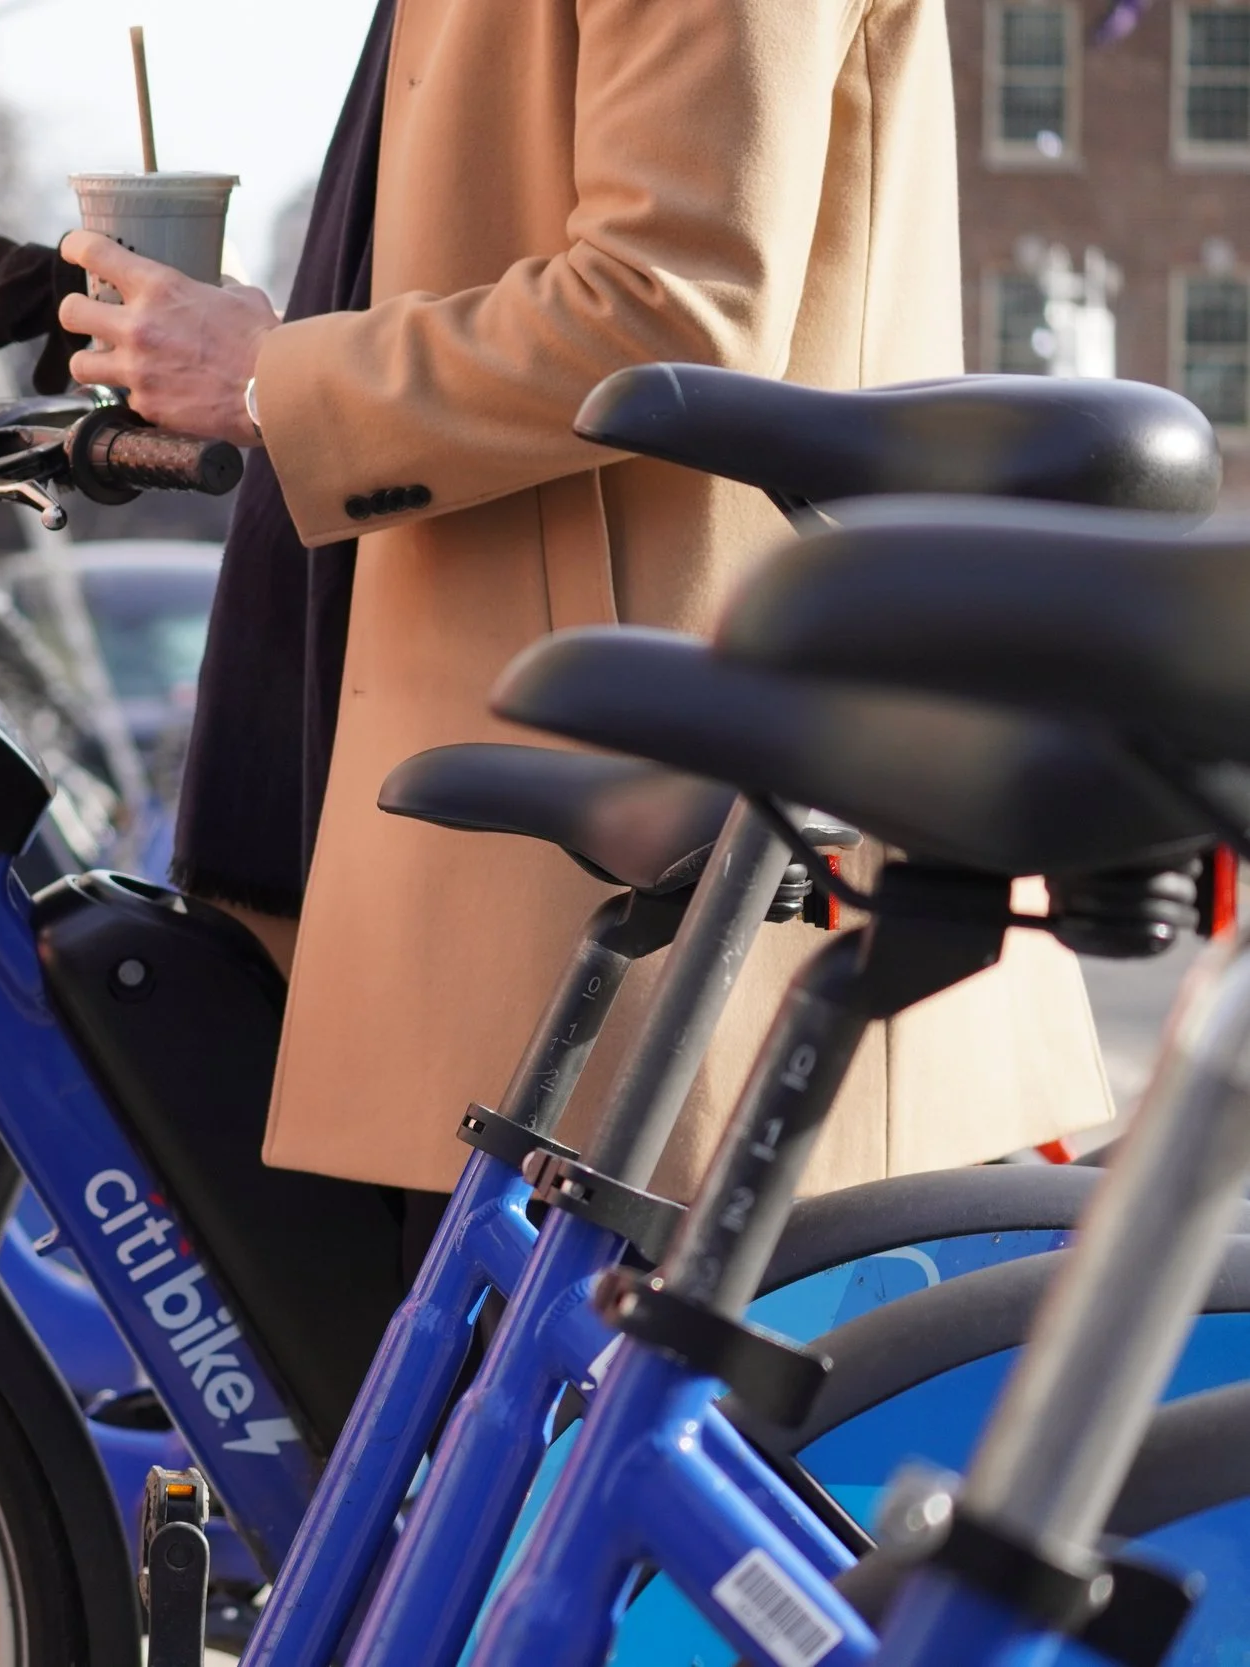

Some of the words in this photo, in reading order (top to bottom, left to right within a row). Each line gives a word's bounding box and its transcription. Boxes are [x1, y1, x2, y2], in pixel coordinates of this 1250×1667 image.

[587, 975, 601, 994] 0
[567, 1022, 579, 1040] 1
[787, 1043, 818, 1078] 0
[142, 1262, 255, 1420] bike
